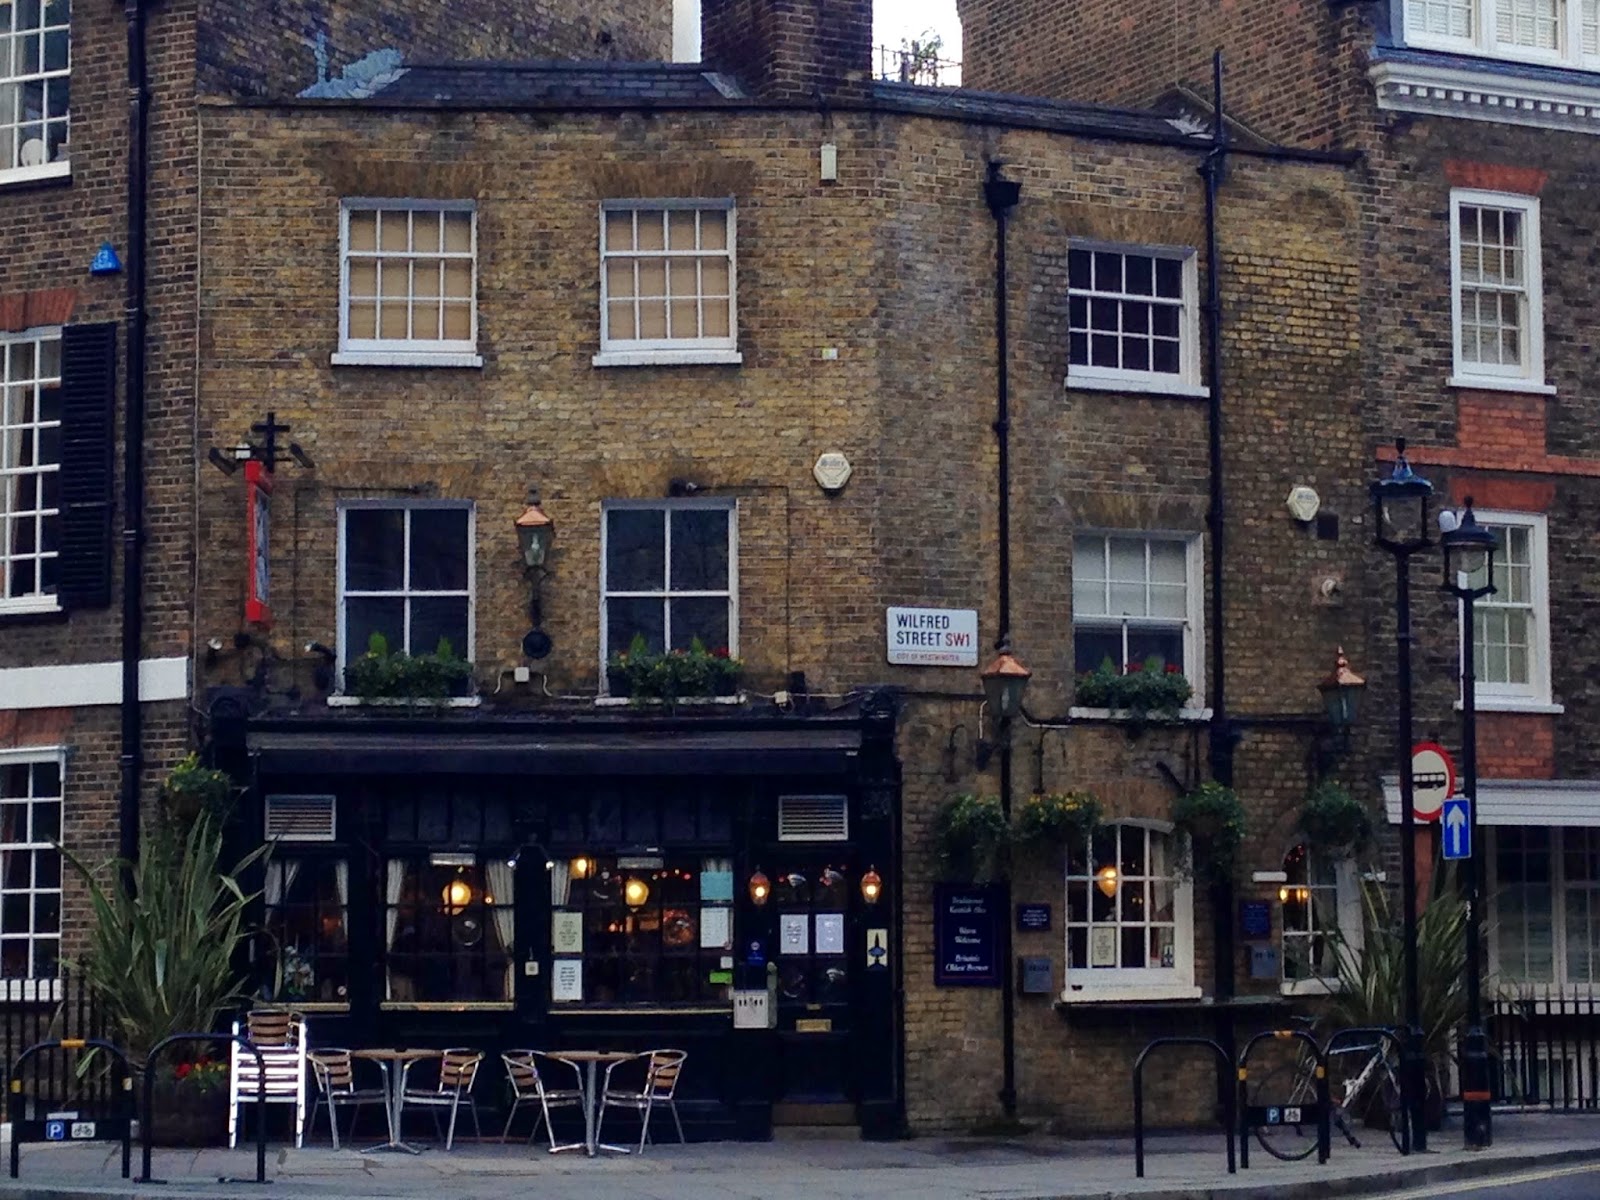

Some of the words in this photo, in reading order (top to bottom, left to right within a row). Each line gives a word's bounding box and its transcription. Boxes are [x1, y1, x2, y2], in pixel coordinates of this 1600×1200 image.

[896, 613, 950, 629] WILFRED
[896, 630, 941, 646] STREET
[945, 632, 970, 647] SW1
[1269, 1109, 1277, 1122] P
[50, 1124, 61, 1138] P
